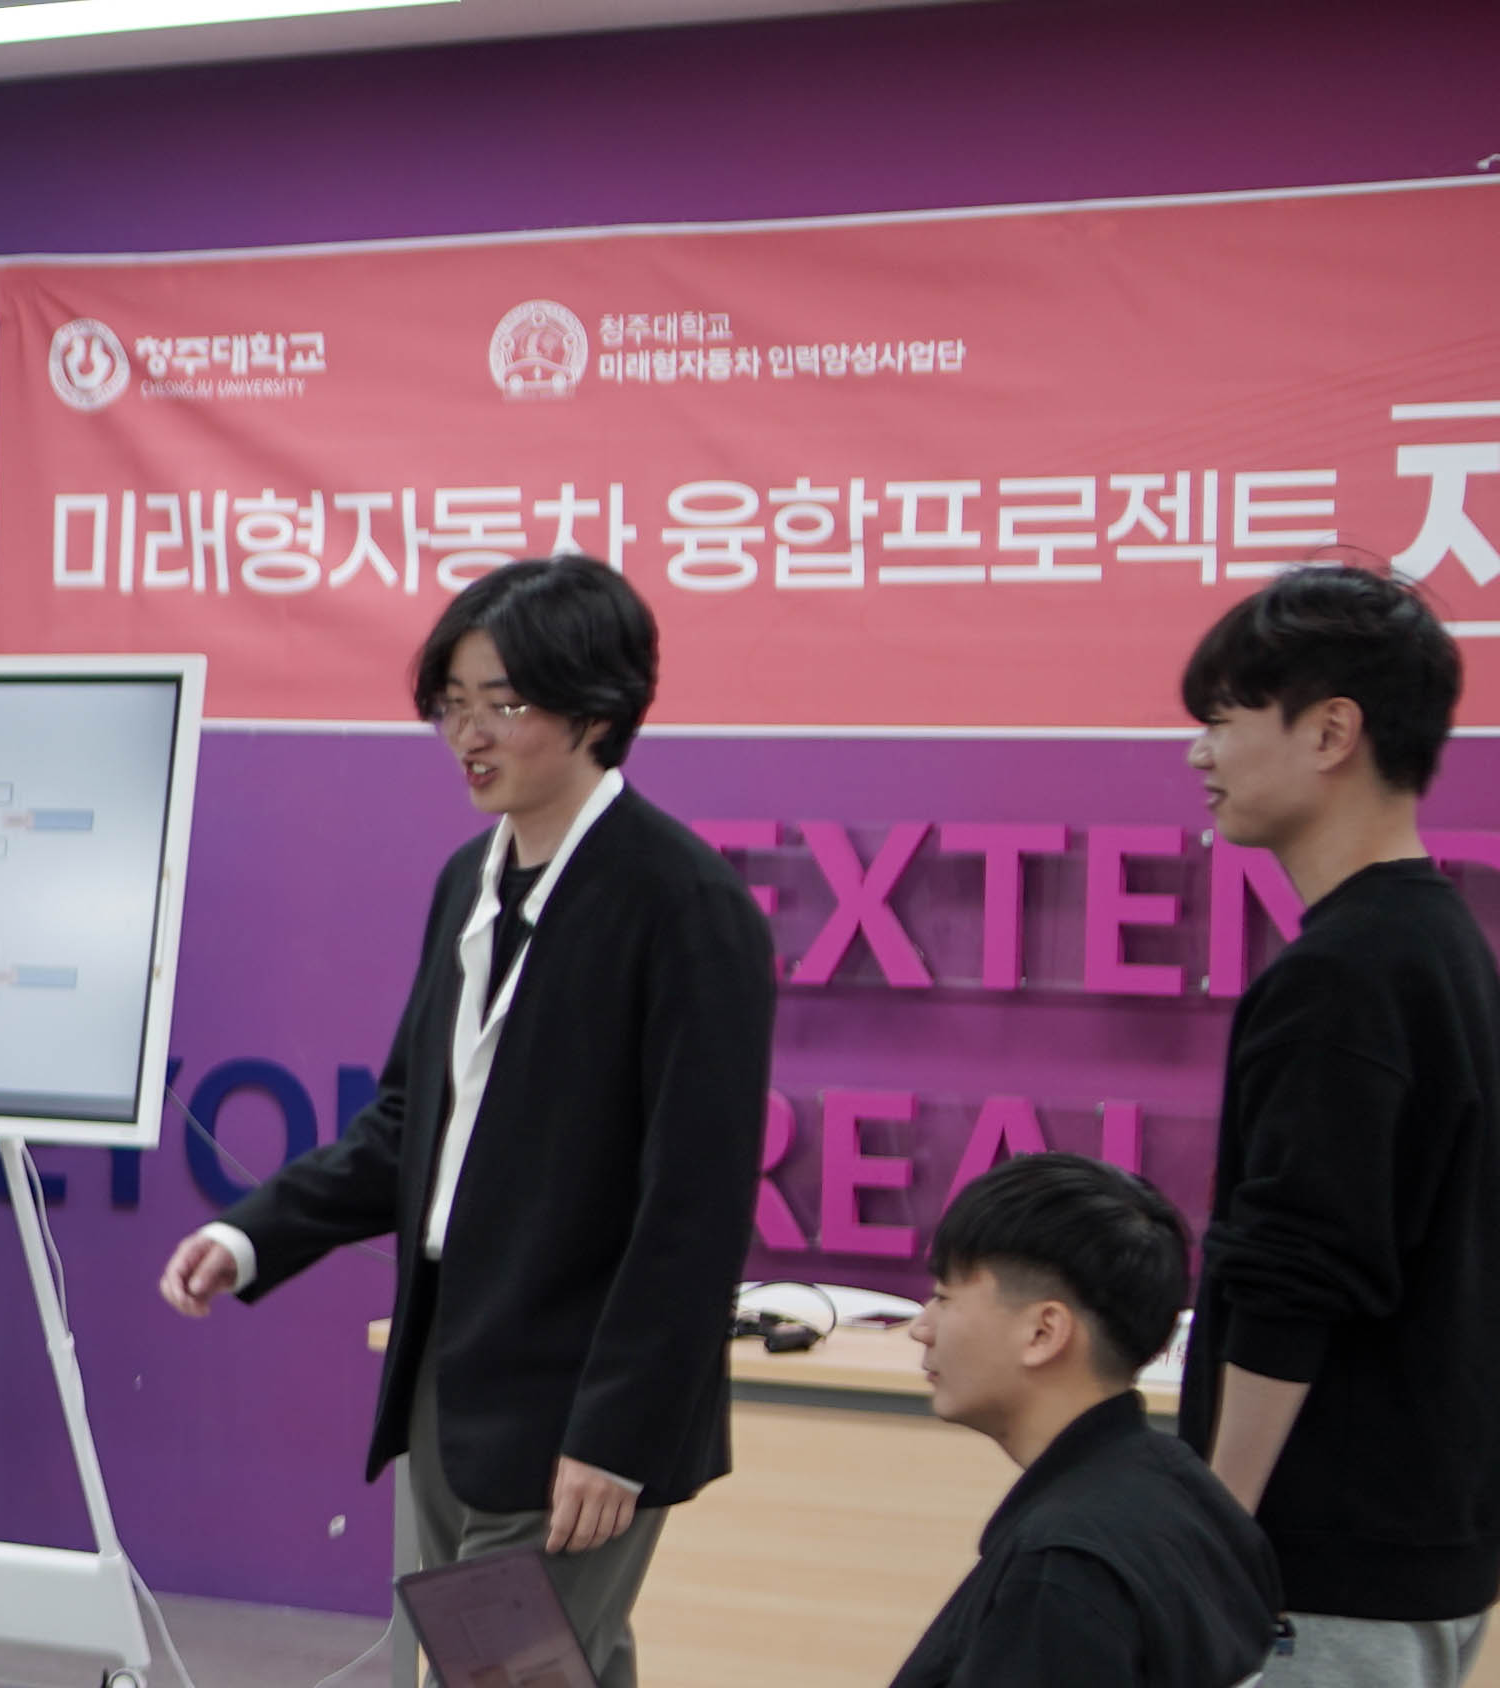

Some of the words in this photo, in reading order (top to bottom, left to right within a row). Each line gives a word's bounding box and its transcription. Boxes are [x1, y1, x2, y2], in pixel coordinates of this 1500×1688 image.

[599, 312, 732, 347] 청주대학교
[134, 332, 327, 376] 청주대학교
[599, 347, 761, 383] 미래형자동차
[768, 338, 966, 378] 인력양성사업단
[217, 376, 306, 396] UNIVERSITY
[53, 482, 638, 596] 미래형자동차
[661, 468, 1339, 591] 융합프로젝트
